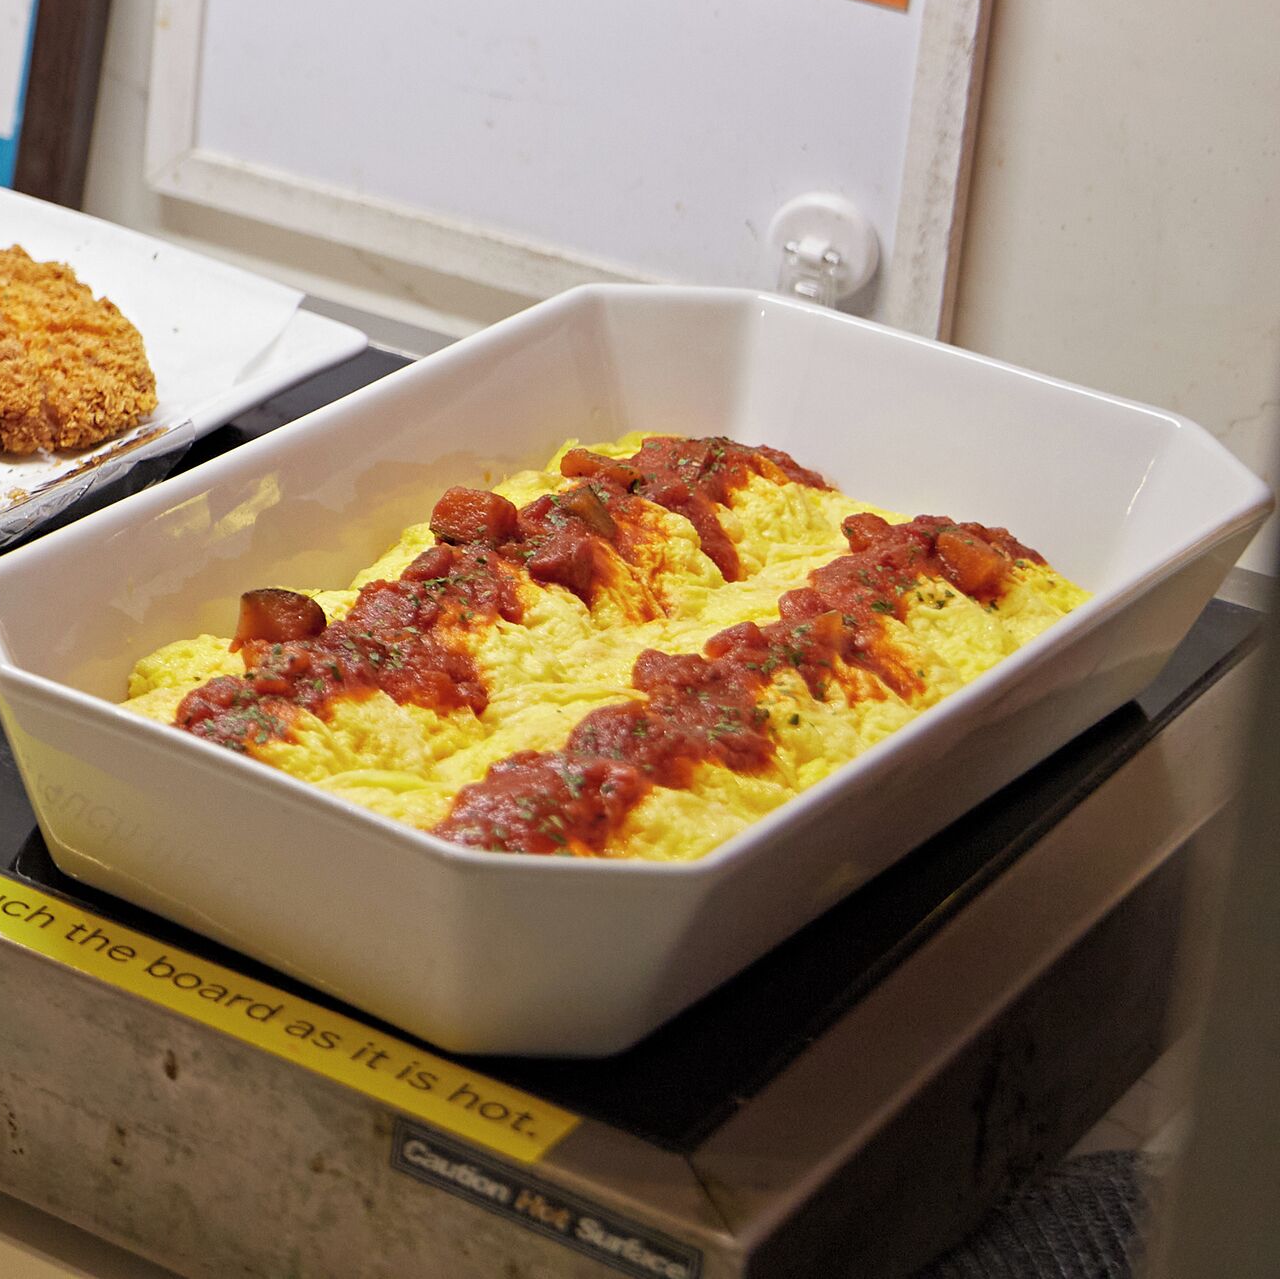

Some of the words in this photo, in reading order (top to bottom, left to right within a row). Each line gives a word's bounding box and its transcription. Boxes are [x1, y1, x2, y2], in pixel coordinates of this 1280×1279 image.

[64, 920, 137, 964] the
[143, 955, 284, 1022] board
[284, 1016, 341, 1051] as
[350, 1040, 393, 1071] it
[394, 1060, 440, 1091] is
[446, 1082, 537, 1139] hot.
[403, 1138, 513, 1204] Caution
[573, 1217, 688, 1279] Surface
